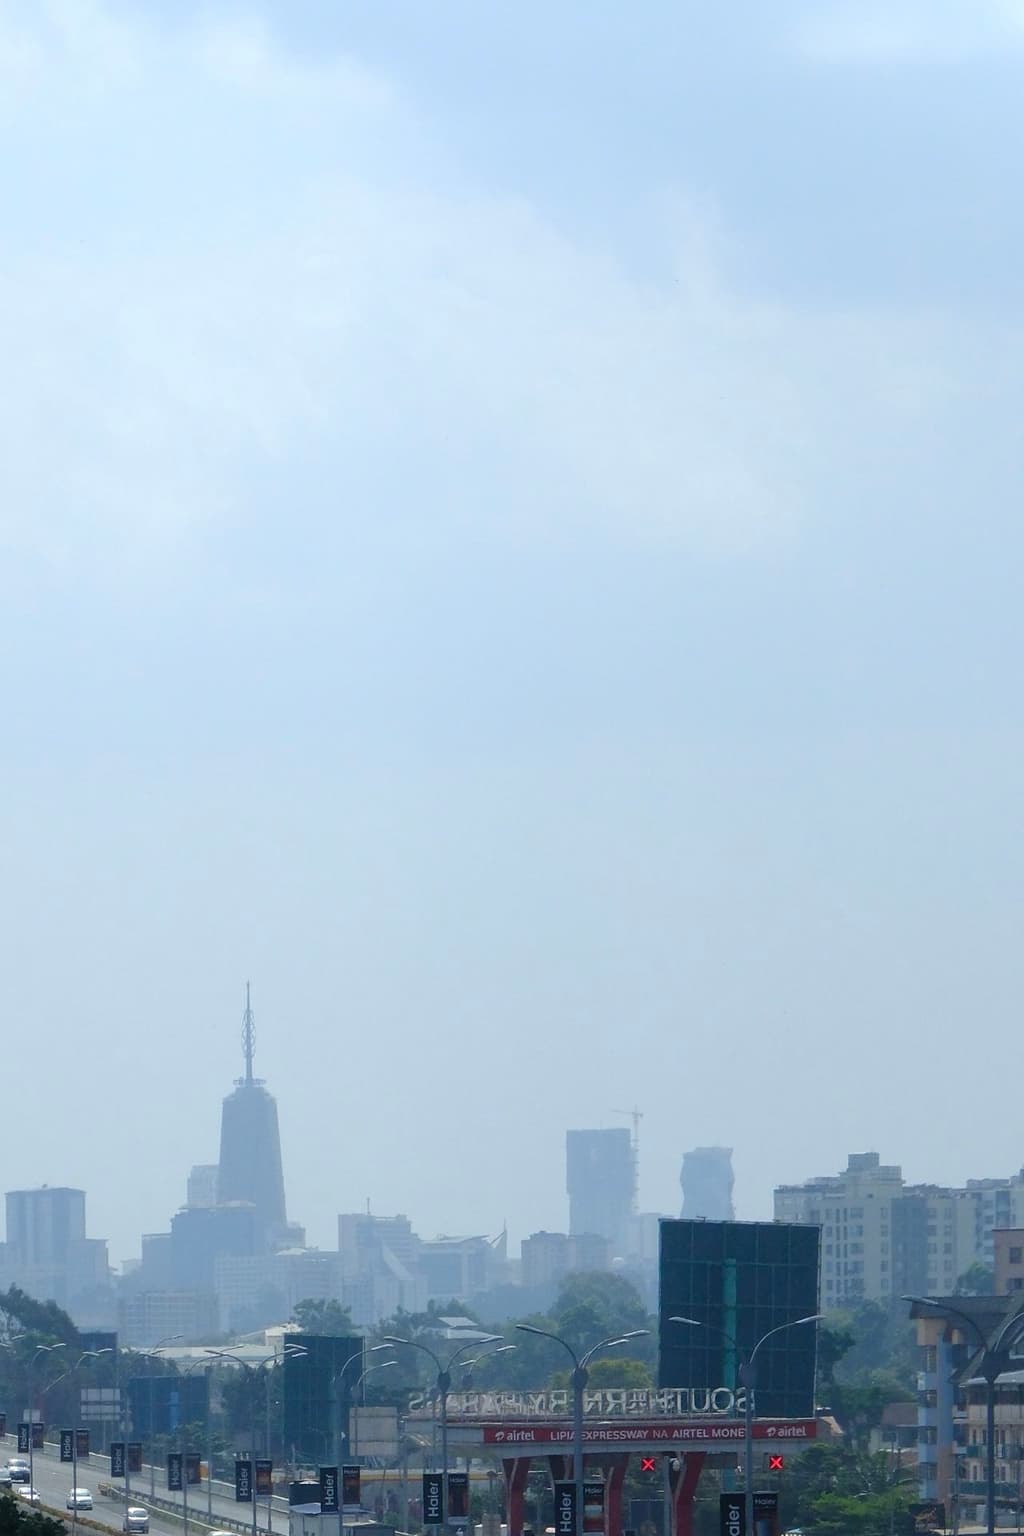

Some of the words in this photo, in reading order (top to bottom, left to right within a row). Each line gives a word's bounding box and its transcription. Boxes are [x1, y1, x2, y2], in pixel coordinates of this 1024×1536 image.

[507, 1429, 535, 1441] airtel
[580, 1430, 649, 1440] EXPRESSWAY
[652, 1430, 669, 1440] NA
[672, 1428, 709, 1438] AIRTEL
[711, 1427, 746, 1438] MONE
[778, 1425, 807, 1437] airtel
[239, 1467, 249, 1497] Haier
[324, 1473, 335, 1506] Haier
[427, 1481, 439, 1517] Haier
[559, 1491, 572, 1533] Haier
